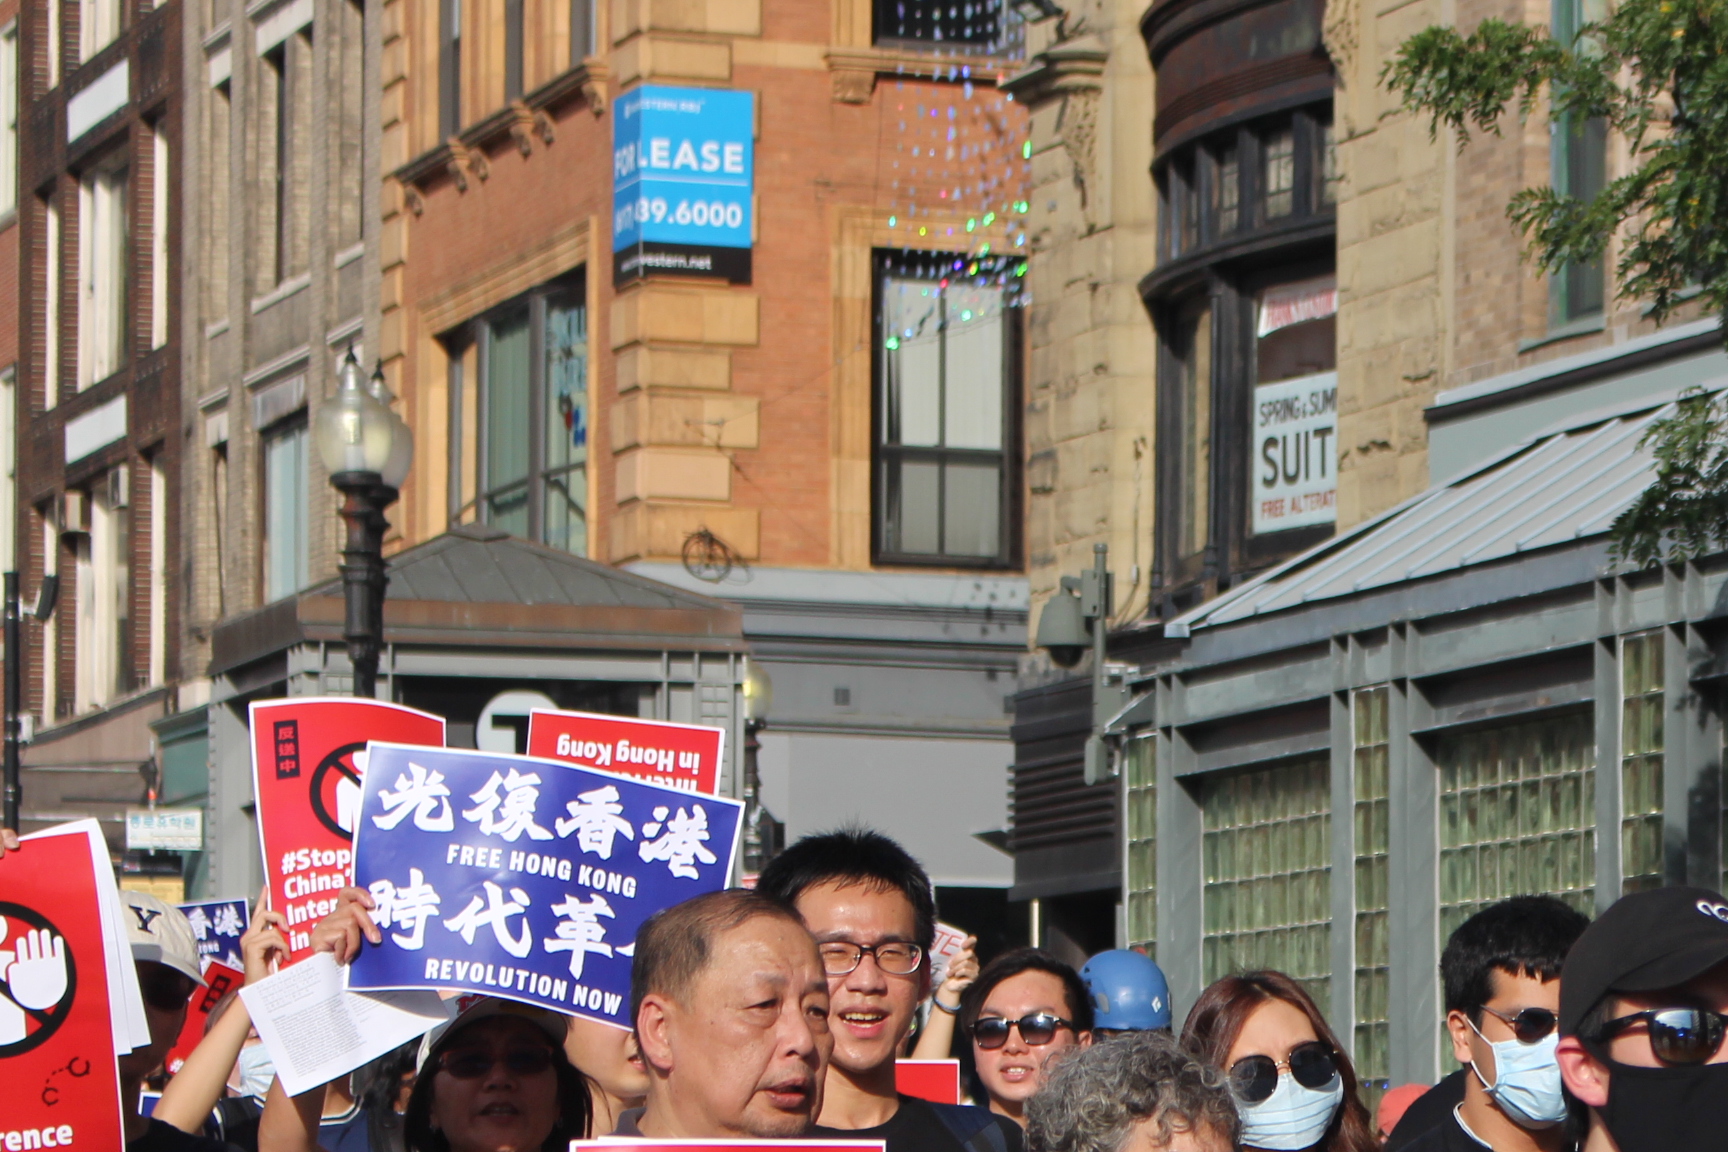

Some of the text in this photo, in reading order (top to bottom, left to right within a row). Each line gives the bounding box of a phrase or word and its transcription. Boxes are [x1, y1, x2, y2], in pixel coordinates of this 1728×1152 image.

[637, 138, 745, 174] LEASE
[1260, 396, 1299, 427] SPRING
[1261, 426, 1334, 489] SUIT
[1261, 498, 1285, 519] FREE
[556, 733, 612, 766] Kong
[616, 739, 675, 772] Hong
[372, 762, 717, 880] 光復香港
[282, 848, 351, 875] #Stop
[446, 844, 637, 898] FREE HONG KONG
[128, 904, 162, 934] Y
[369, 867, 635, 980] 時代革
[425, 959, 622, 1016] REVOLUTION NOW
